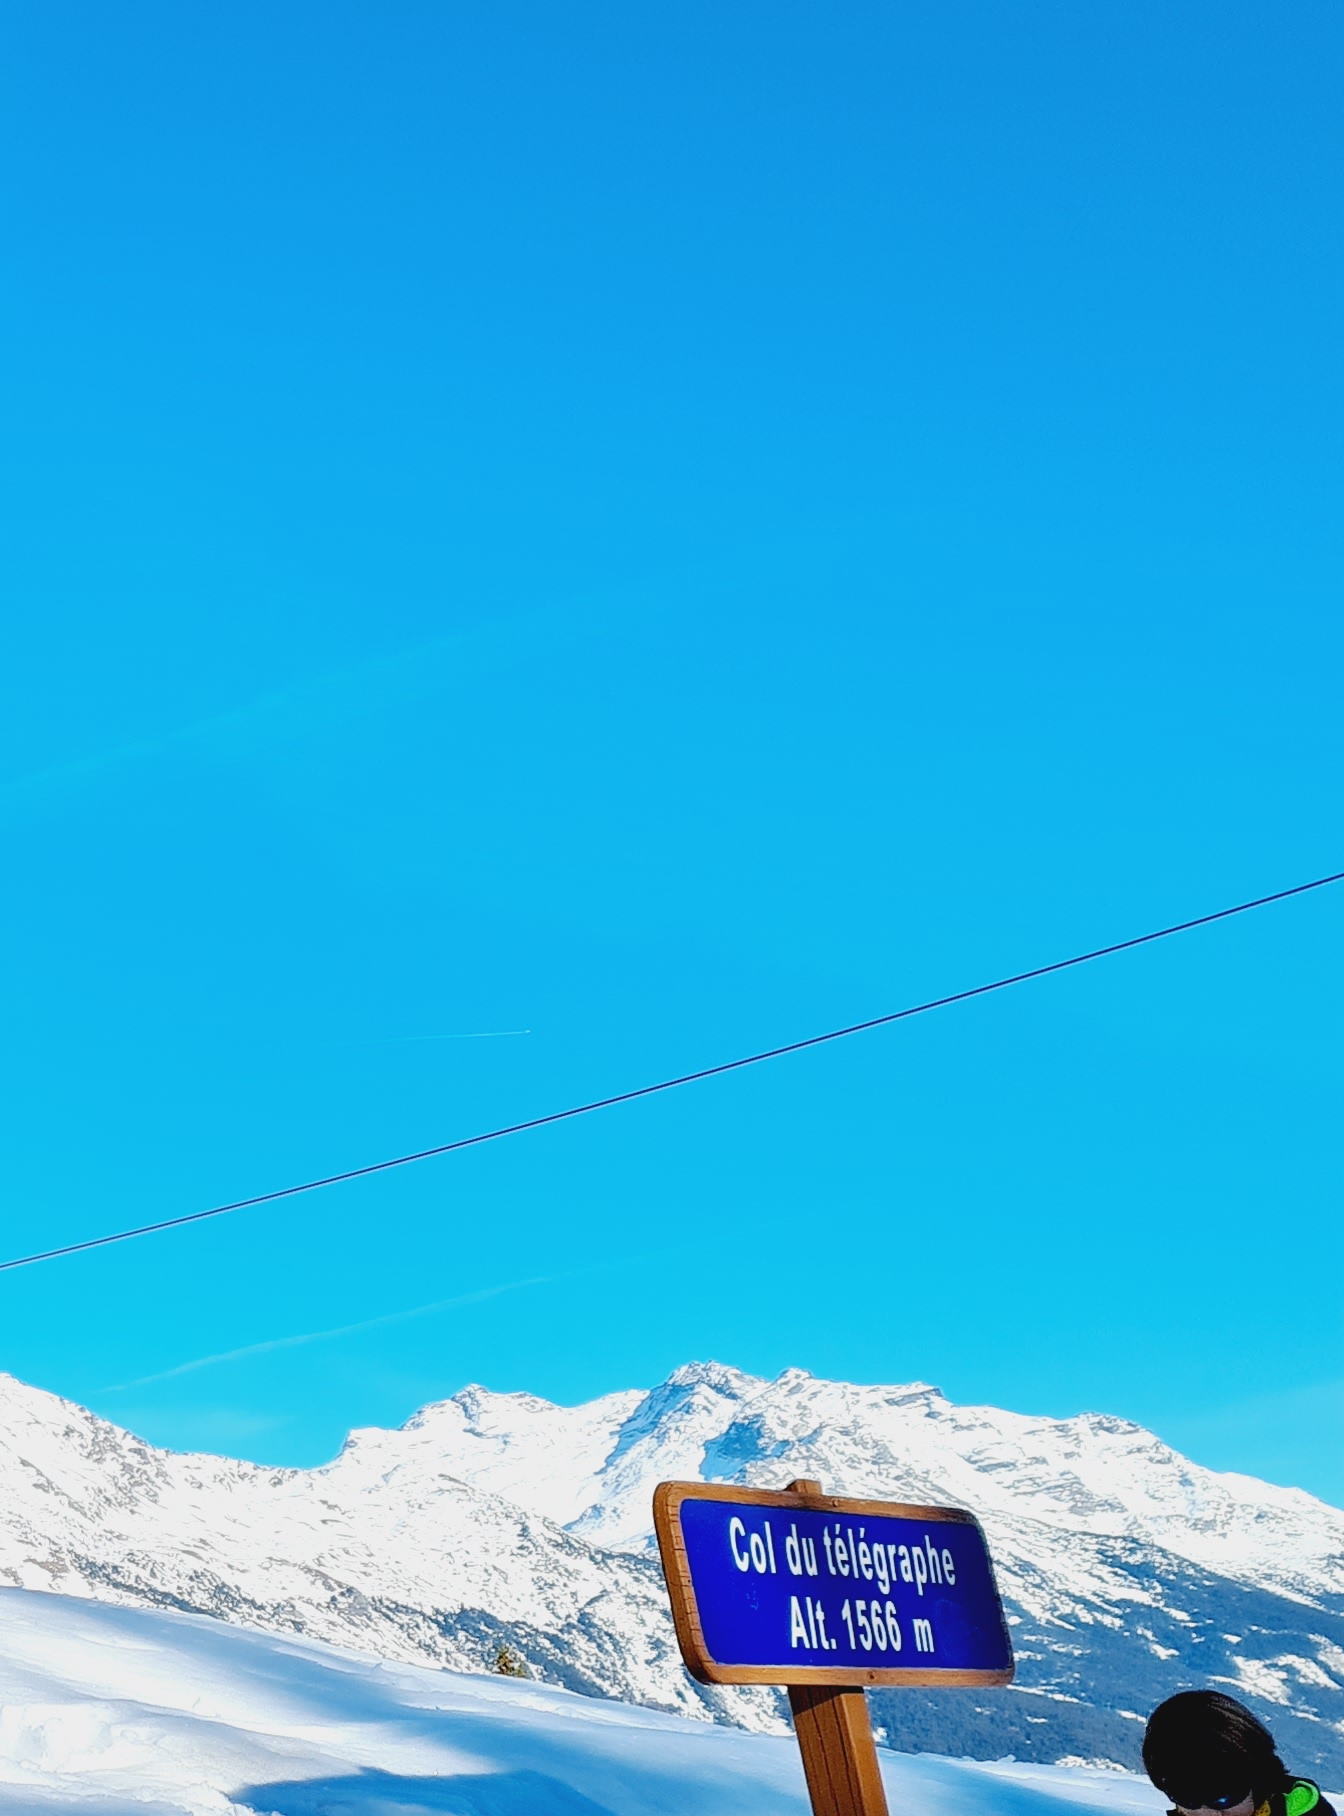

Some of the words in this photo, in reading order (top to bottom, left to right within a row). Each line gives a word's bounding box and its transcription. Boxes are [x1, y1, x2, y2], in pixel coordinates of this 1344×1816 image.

[728, 1516, 777, 1575] Col
[785, 1524, 818, 1577] du
[823, 1523, 957, 1596] télégraphe
[790, 1595, 837, 1650] Alt.
[841, 1599, 903, 1652] 1566
[913, 1618, 936, 1653] m
